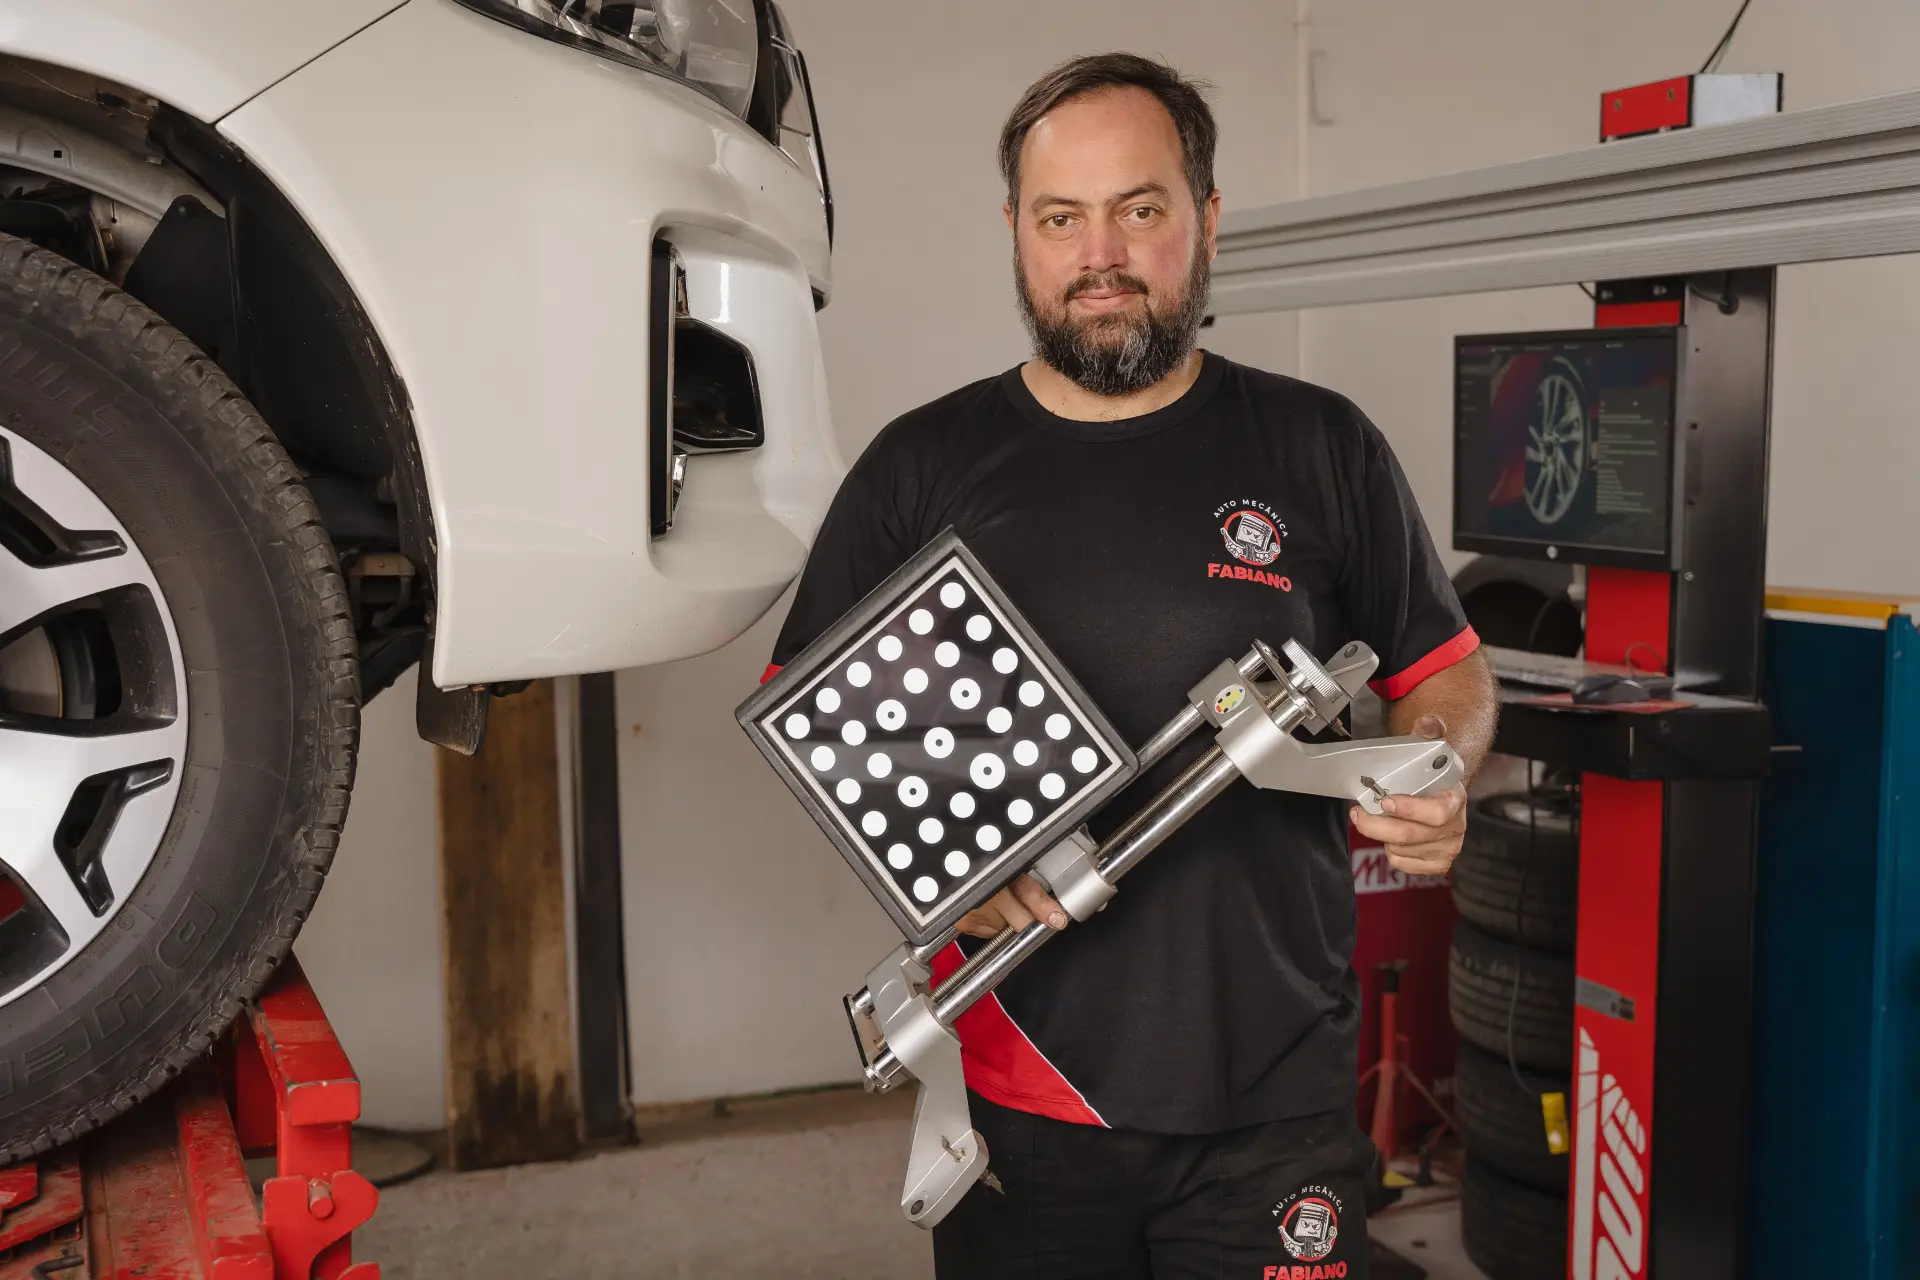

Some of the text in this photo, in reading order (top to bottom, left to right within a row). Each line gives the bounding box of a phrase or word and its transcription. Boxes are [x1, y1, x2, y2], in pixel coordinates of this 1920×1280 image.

[1213, 500, 1236, 518] AUTO
[1207, 562, 1292, 592] FABIANO
[0, 891, 218, 1099] DUE
[1272, 1193, 1296, 1217] AUTO
[1263, 1260, 1347, 1280] FABIANO
